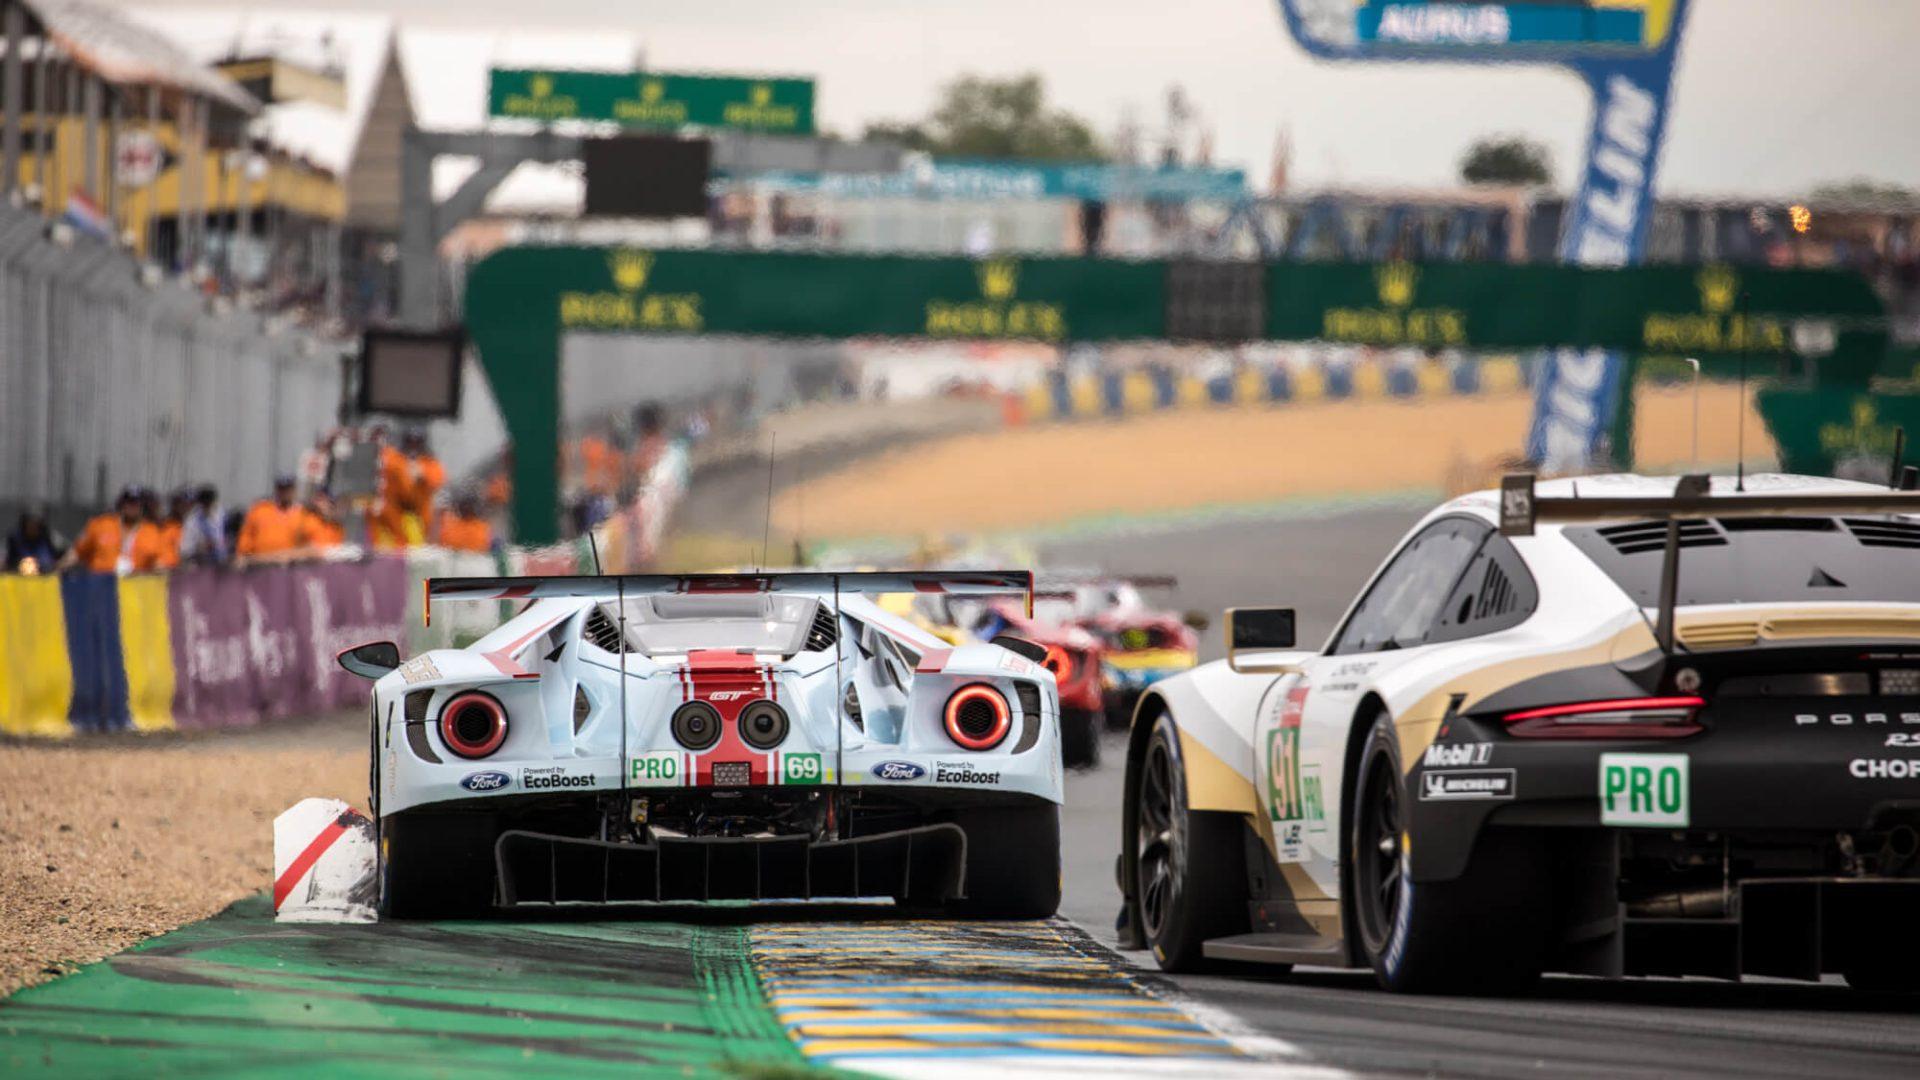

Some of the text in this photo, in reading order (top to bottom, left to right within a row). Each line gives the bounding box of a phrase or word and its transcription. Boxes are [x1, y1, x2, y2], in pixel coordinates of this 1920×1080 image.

[1423, 743, 1475, 766] Mobil
[523, 766, 565, 775] Powered by
[631, 758, 677, 779] PRO
[787, 756, 819, 779] 69
[881, 762, 915, 778] Ford
[936, 761, 975, 769] Powered by
[469, 774, 502, 789] Ford
[523, 773, 596, 788] EcoBoost
[936, 769, 1000, 784] EcoBoost
[1271, 730, 1298, 819] 91
[1606, 765, 1682, 814] PRO
